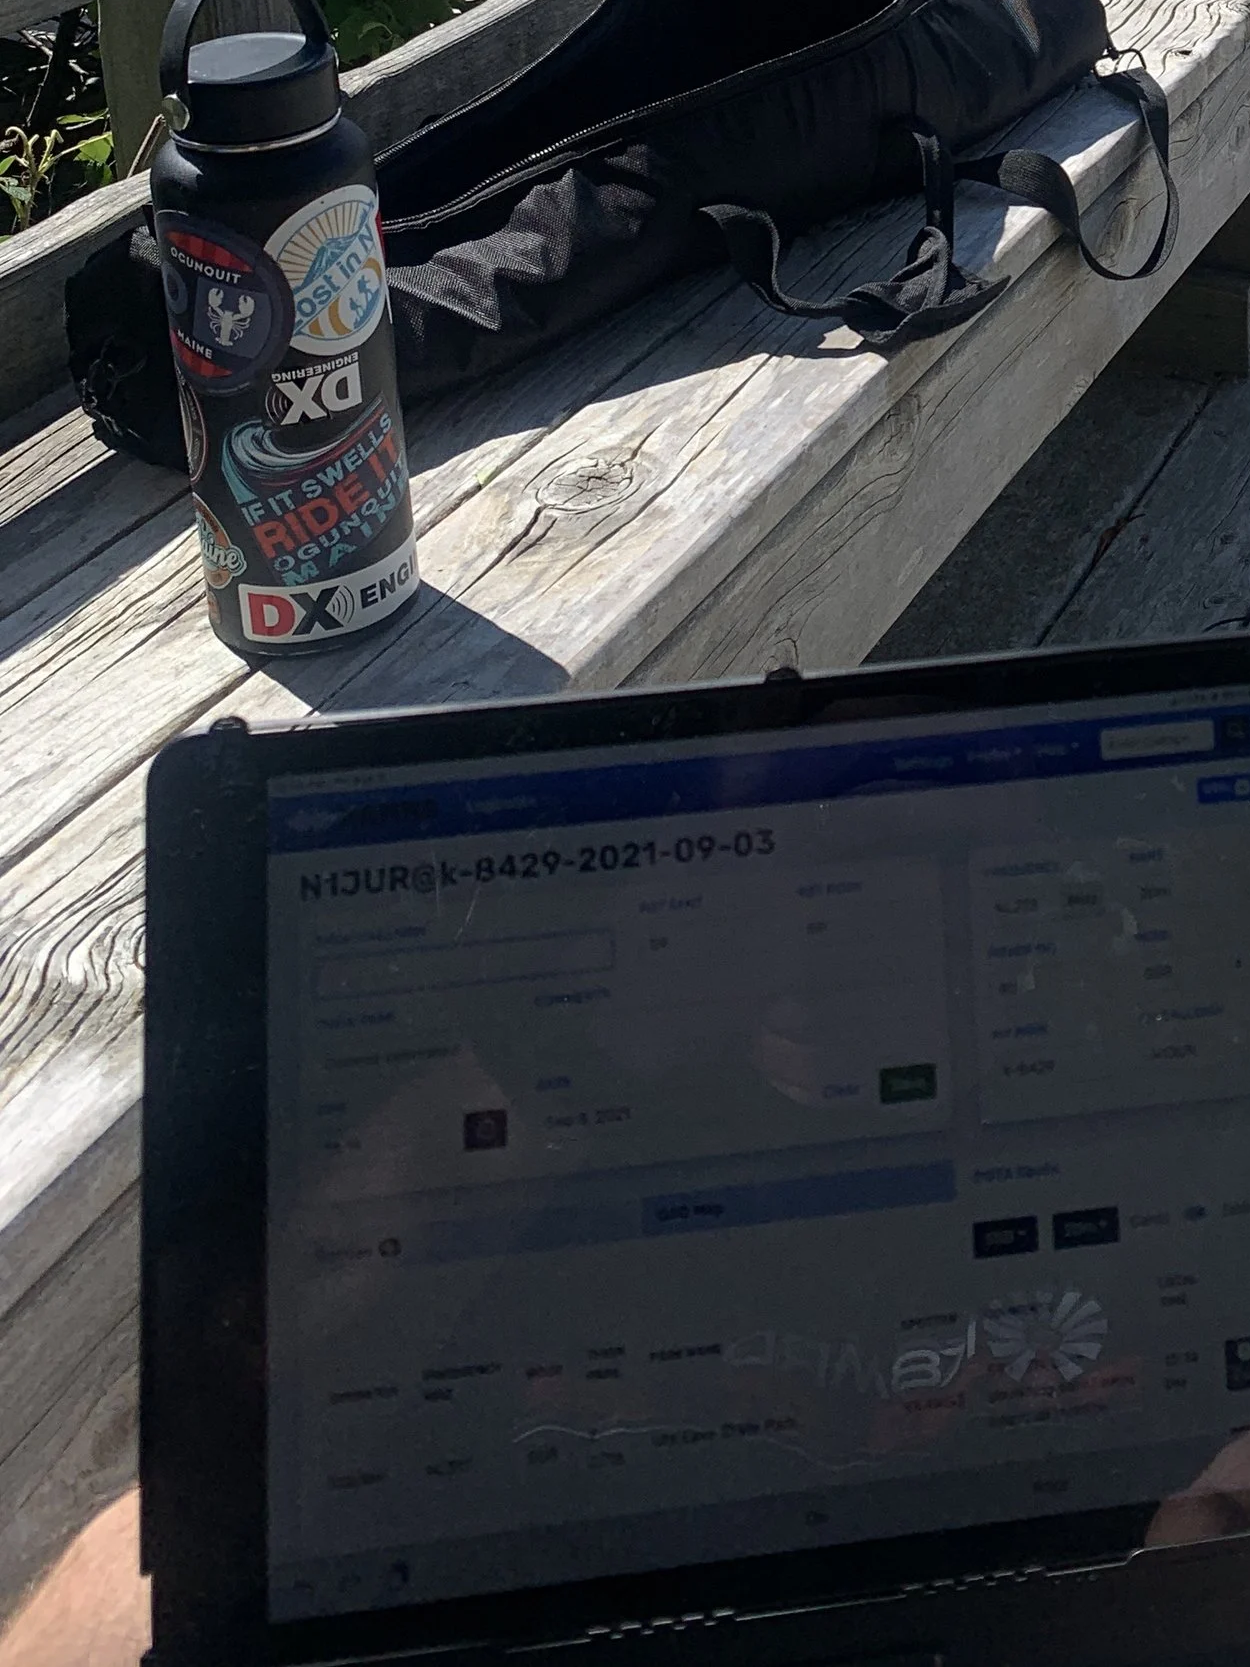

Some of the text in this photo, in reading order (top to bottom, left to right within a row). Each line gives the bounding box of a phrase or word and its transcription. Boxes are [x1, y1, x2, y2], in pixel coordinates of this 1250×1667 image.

[294, 273, 341, 322] ost
[336, 251, 363, 281] in
[177, 328, 214, 360] MAINE
[271, 352, 359, 383] ENGINEERING
[277, 362, 363, 425] DX
[240, 499, 265, 527] IF
[269, 488, 297, 519] IT
[300, 413, 393, 498] SWELLS
[252, 472, 370, 560] RIDE
[368, 434, 399, 483] IT
[246, 586, 344, 638] DX
